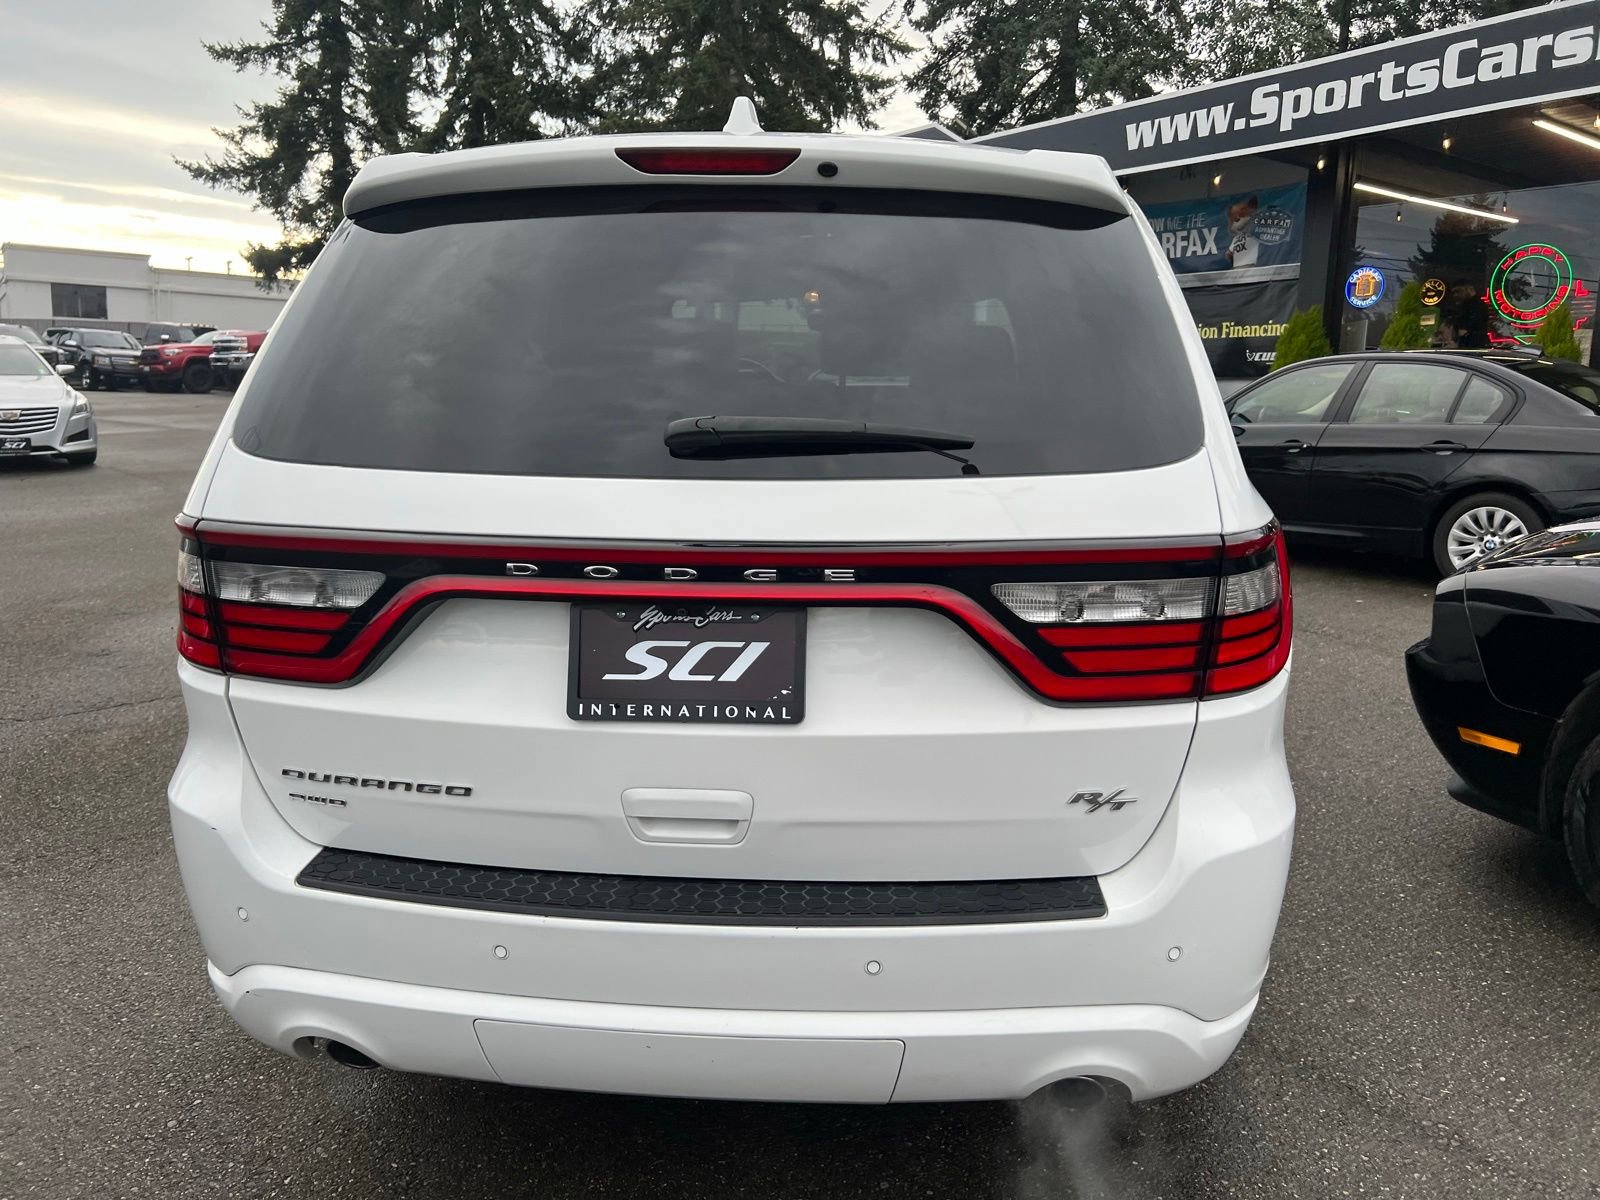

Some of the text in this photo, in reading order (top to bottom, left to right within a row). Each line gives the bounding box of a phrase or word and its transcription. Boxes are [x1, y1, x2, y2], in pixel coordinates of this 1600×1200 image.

[1501, 246, 1563, 270] HAPPY
[1494, 285, 1569, 320] MOTORING
[505, 562, 856, 582] DODGE
[601, 640, 771, 683] SCI
[578, 703, 791, 719] INTERNATIONAL
[281, 768, 473, 797] DURANGO
[1066, 785, 1139, 813] R/T
